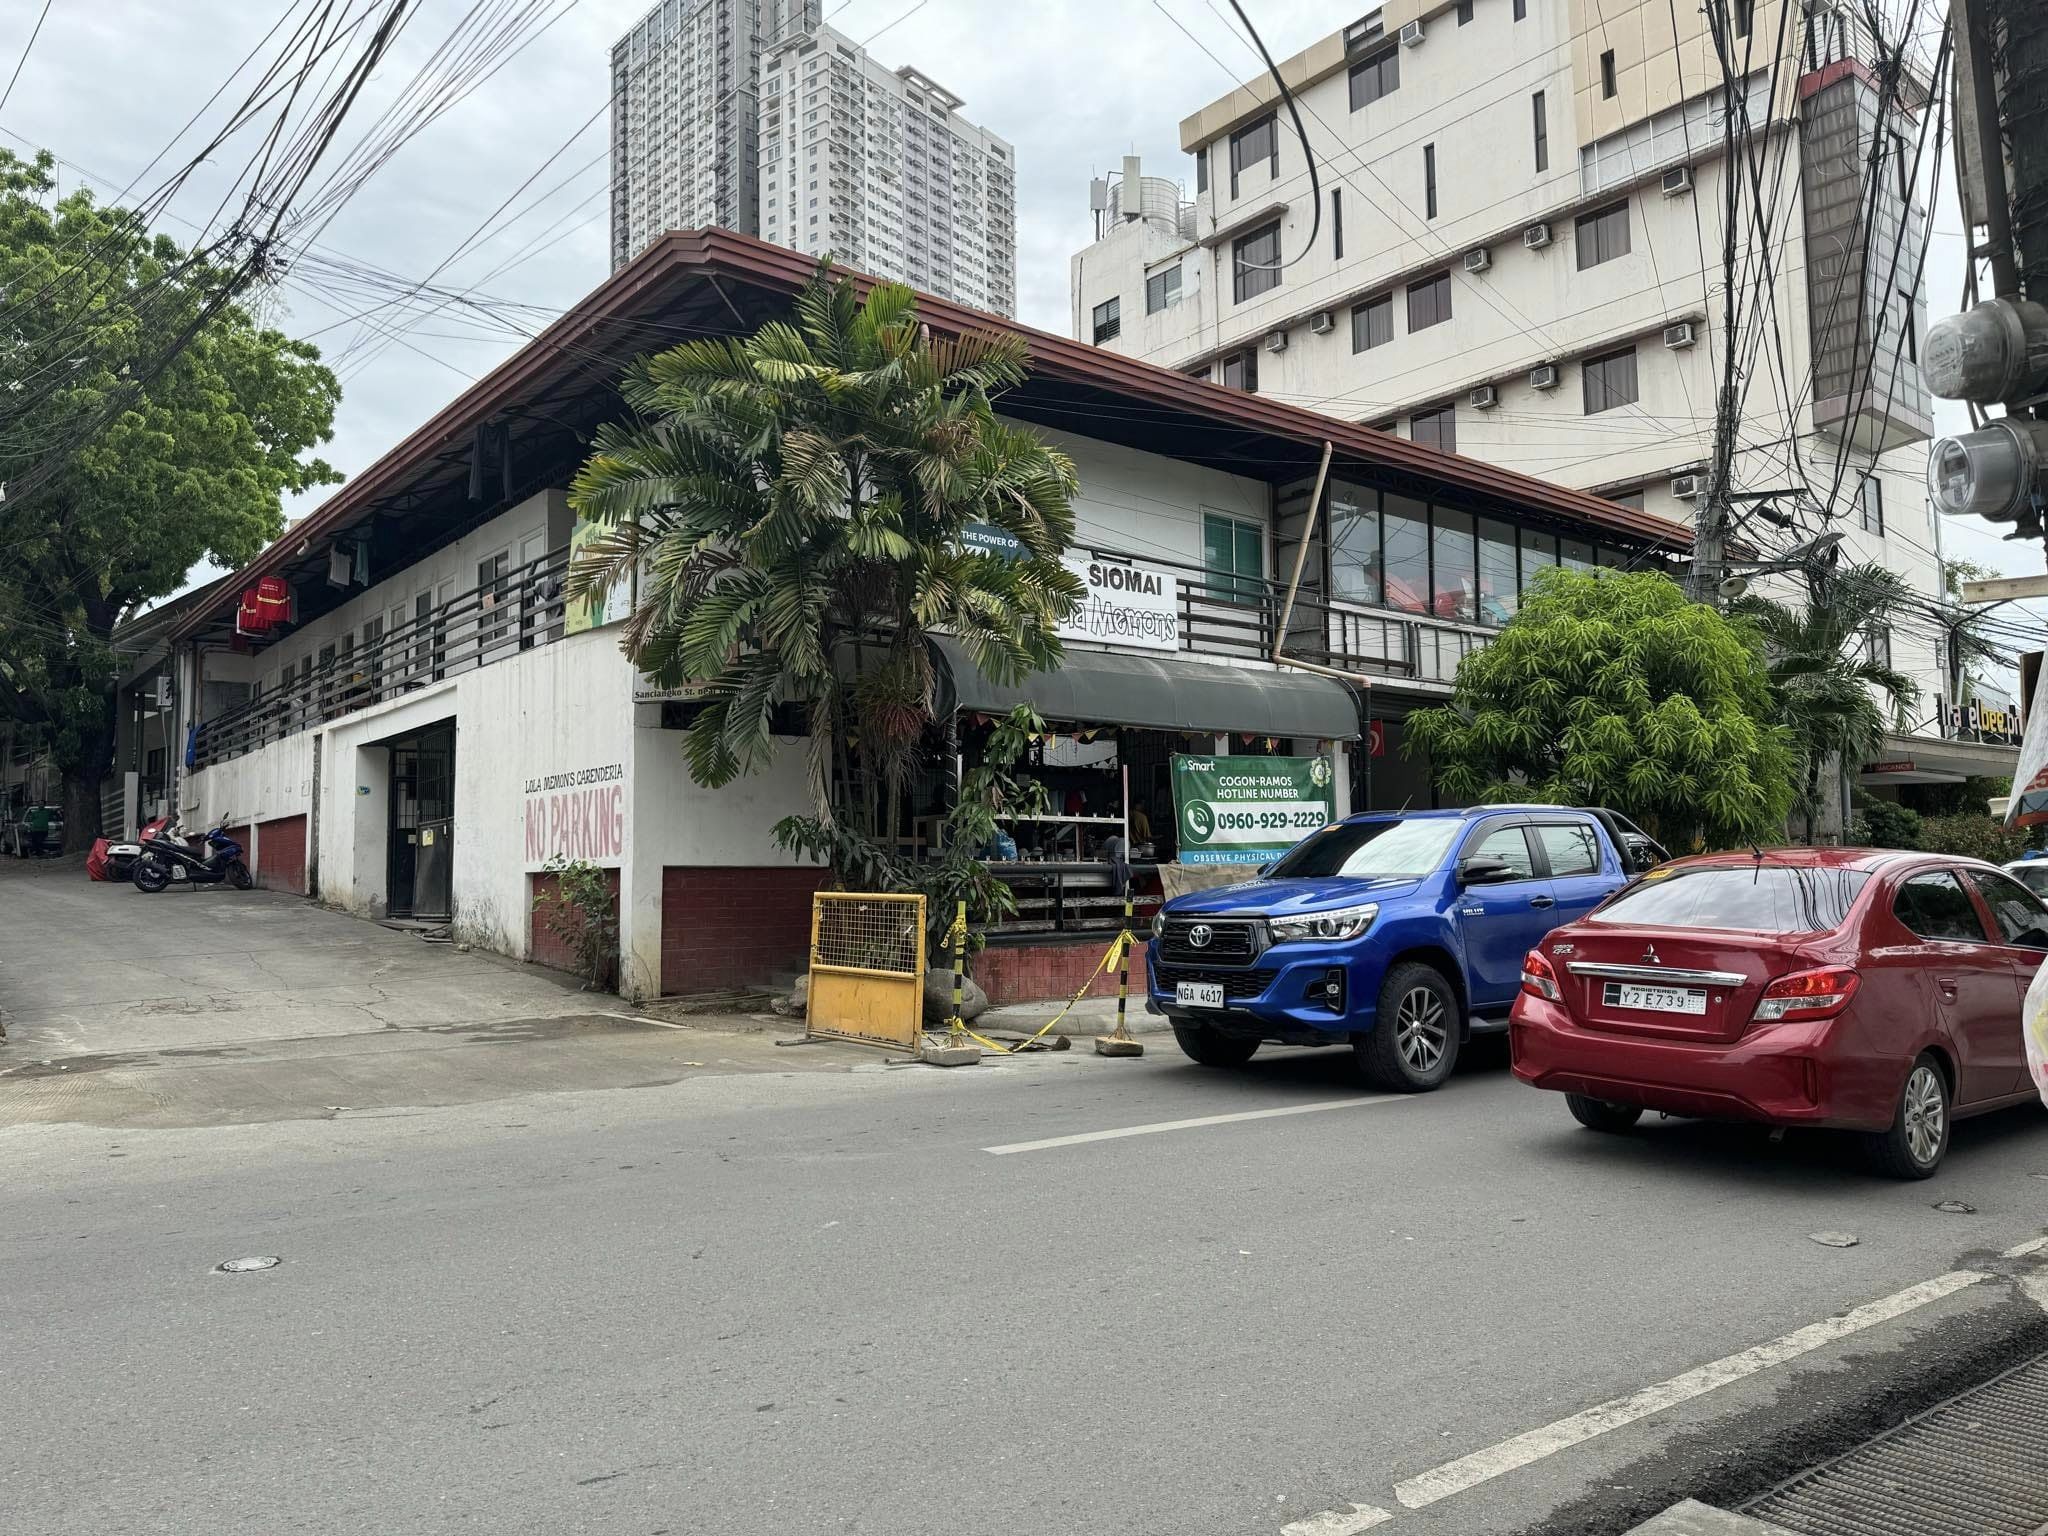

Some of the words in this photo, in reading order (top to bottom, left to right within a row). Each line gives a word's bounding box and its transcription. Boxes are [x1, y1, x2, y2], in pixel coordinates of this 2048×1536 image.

[961, 530, 978, 541] THE
[978, 533, 1007, 547] POWER
[1007, 538, 1019, 548] OF
[1088, 563, 1162, 596] SIOMAI
[635, 687, 682, 699] Sanciangko
[684, 688, 695, 696] St.
[1188, 760, 1216, 772] Smart
[525, 778, 542, 794] LOLA
[576, 763, 623, 786] CARENDERIA
[1219, 776, 1293, 787] COGON-RAMOS
[1216, 789, 1258, 799] HOTLINE
[1260, 788, 1299, 799] NUMBER
[525, 797, 546, 863] NO
[551, 784, 623, 859] PARKING
[1217, 811, 1326, 830] 0960-929-2229
[1193, 853, 1231, 863] OBSERVE
[1234, 852, 1276, 862] PHYSICAL
[1177, 985, 1195, 1000] NGA
[1200, 988, 1222, 1003] 4617
[1630, 986, 1678, 995] REGISTERED
